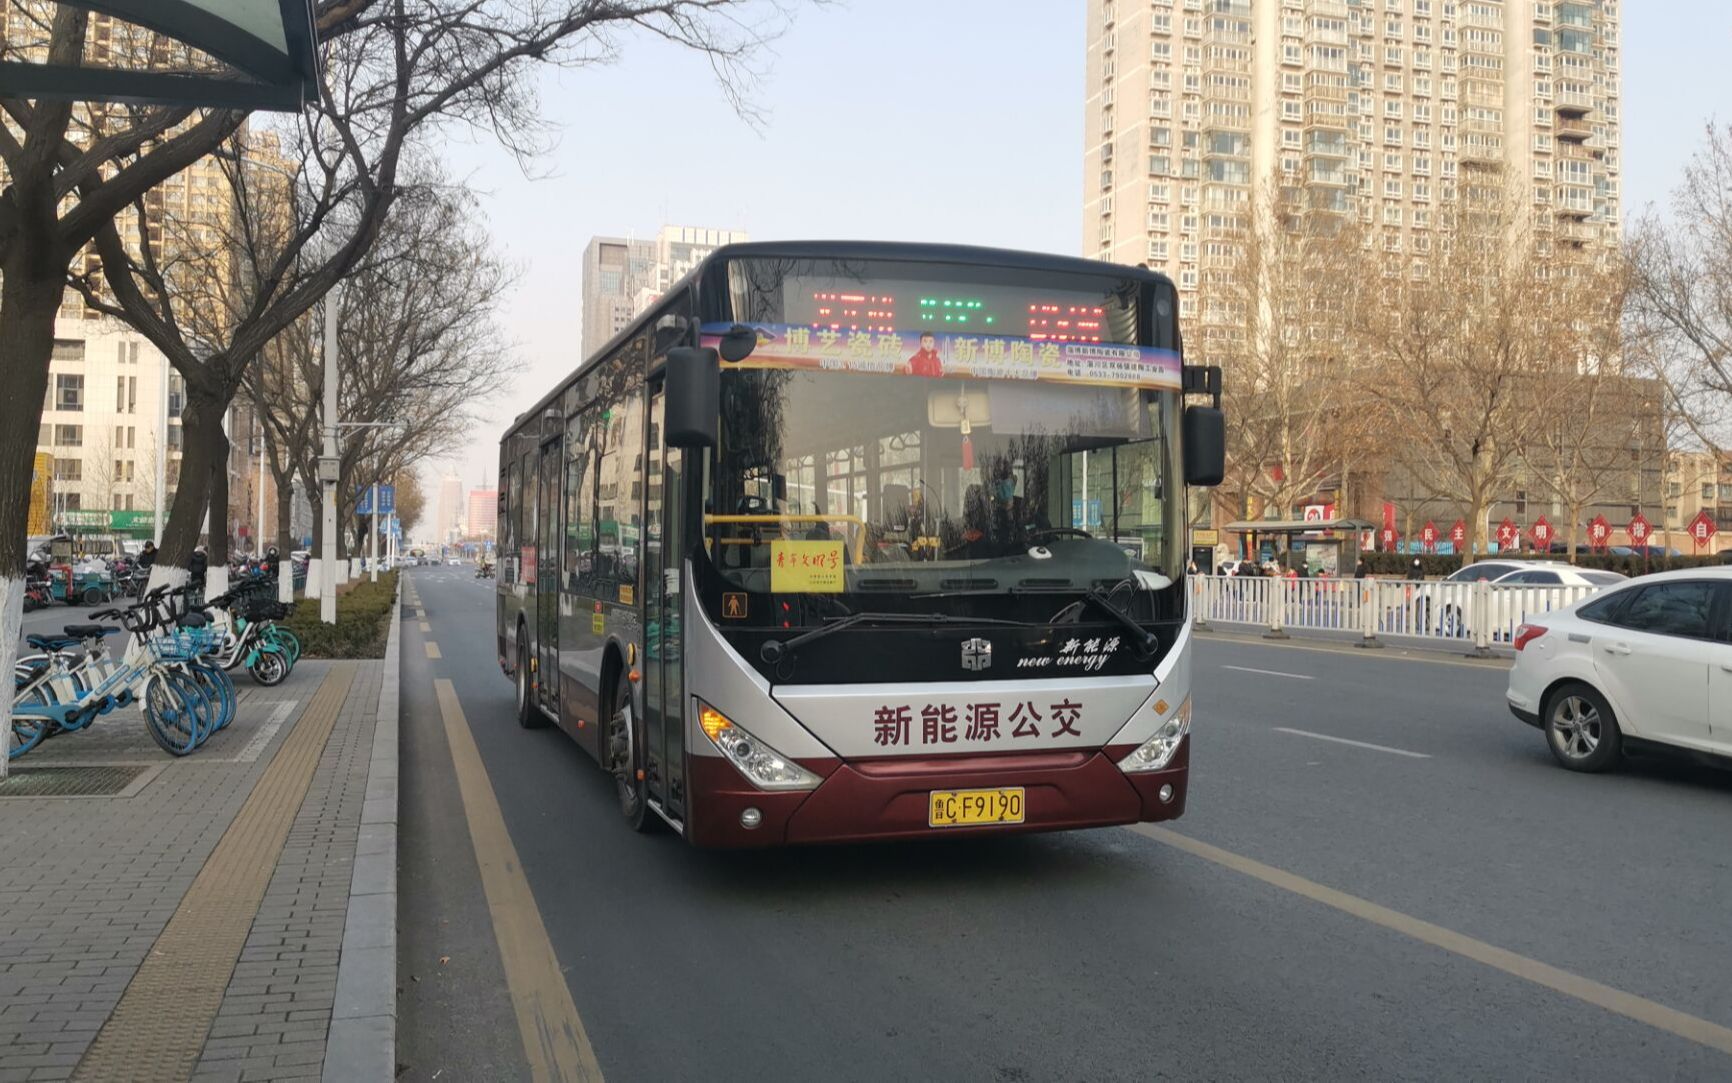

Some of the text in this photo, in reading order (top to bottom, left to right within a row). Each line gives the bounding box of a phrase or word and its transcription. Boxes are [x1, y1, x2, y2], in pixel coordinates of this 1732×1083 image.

[784, 327, 903, 357] 博艺瓷砖
[954, 336, 1060, 368] 新博陶瓷
[1424, 527, 1464, 541] 民 主
[1501, 525, 1547, 539] 文 明
[1593, 522, 1645, 538] 和 谐
[1695, 523, 1707, 538] 自
[1017, 654, 1111, 671] new energy
[873, 697, 1083, 747] 新能源公交
